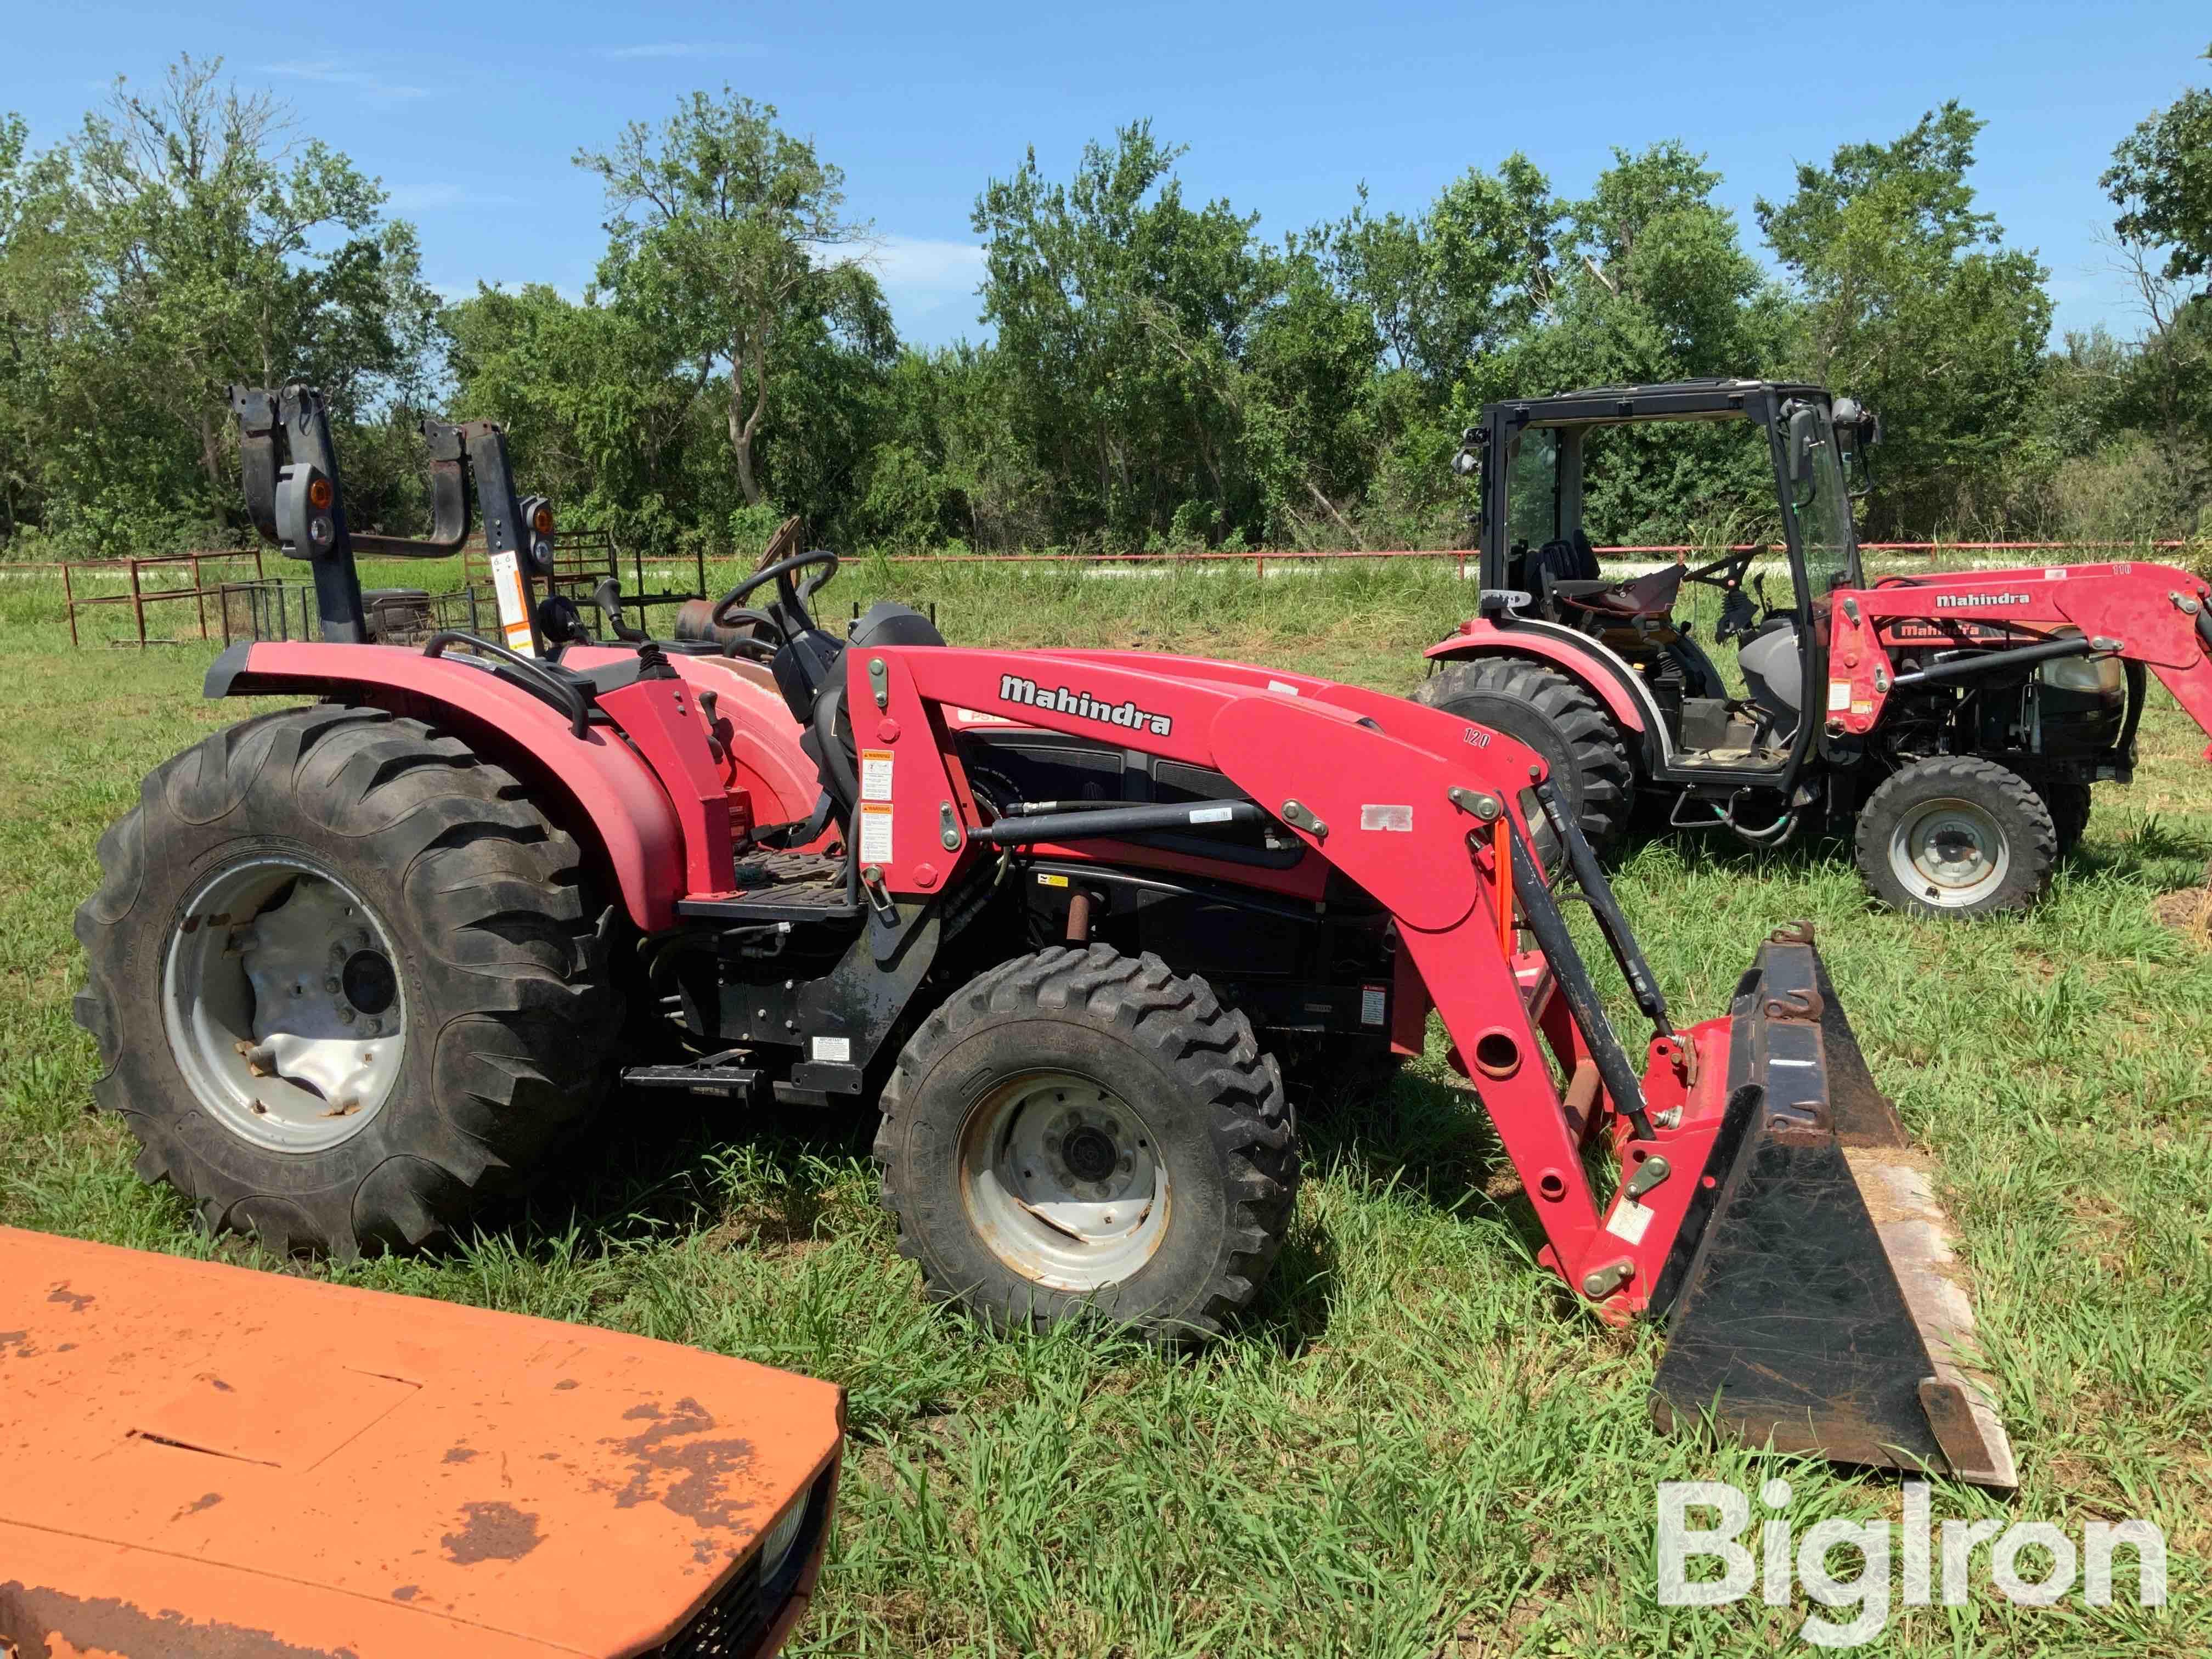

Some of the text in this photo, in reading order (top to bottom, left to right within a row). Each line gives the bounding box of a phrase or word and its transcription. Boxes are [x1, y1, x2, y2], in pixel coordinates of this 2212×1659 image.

[1937, 592, 2029, 606] Mahindra
[1000, 675, 1170, 735] Mahindra
[1464, 728, 1491, 748] 120
